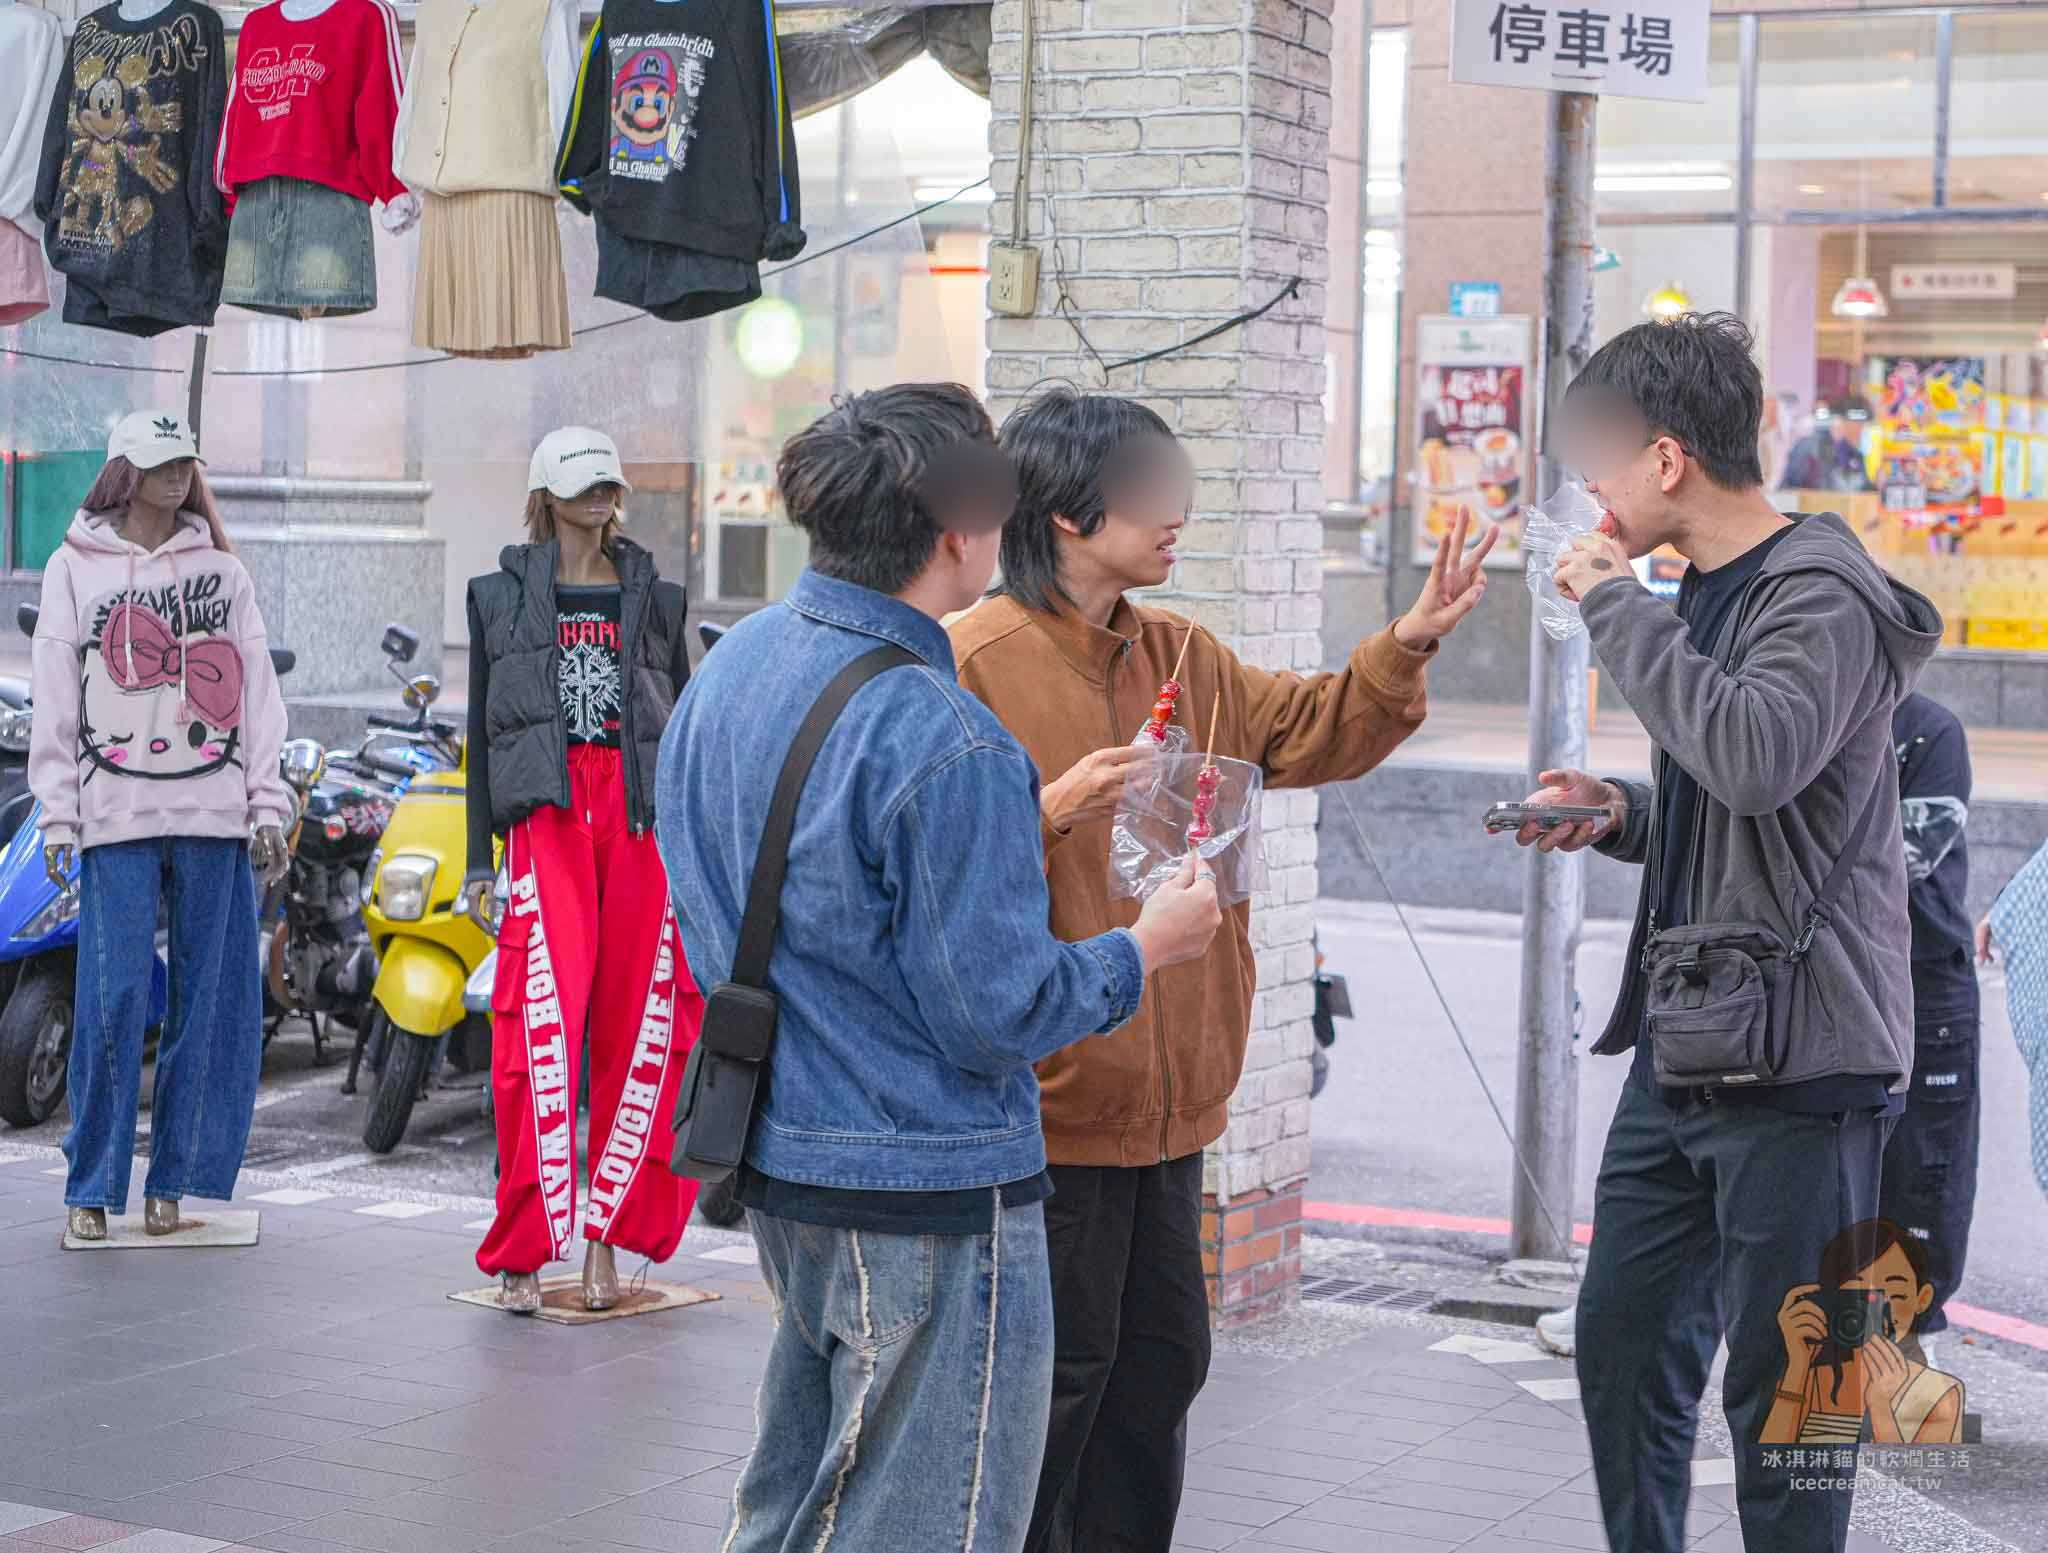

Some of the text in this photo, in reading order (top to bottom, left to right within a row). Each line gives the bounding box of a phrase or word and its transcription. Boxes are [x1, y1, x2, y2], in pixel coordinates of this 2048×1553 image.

[1489, 4, 1674, 76] 停車場
[532, 1034, 567, 1118] THE
[585, 991, 672, 1230] PLOUGH THE
